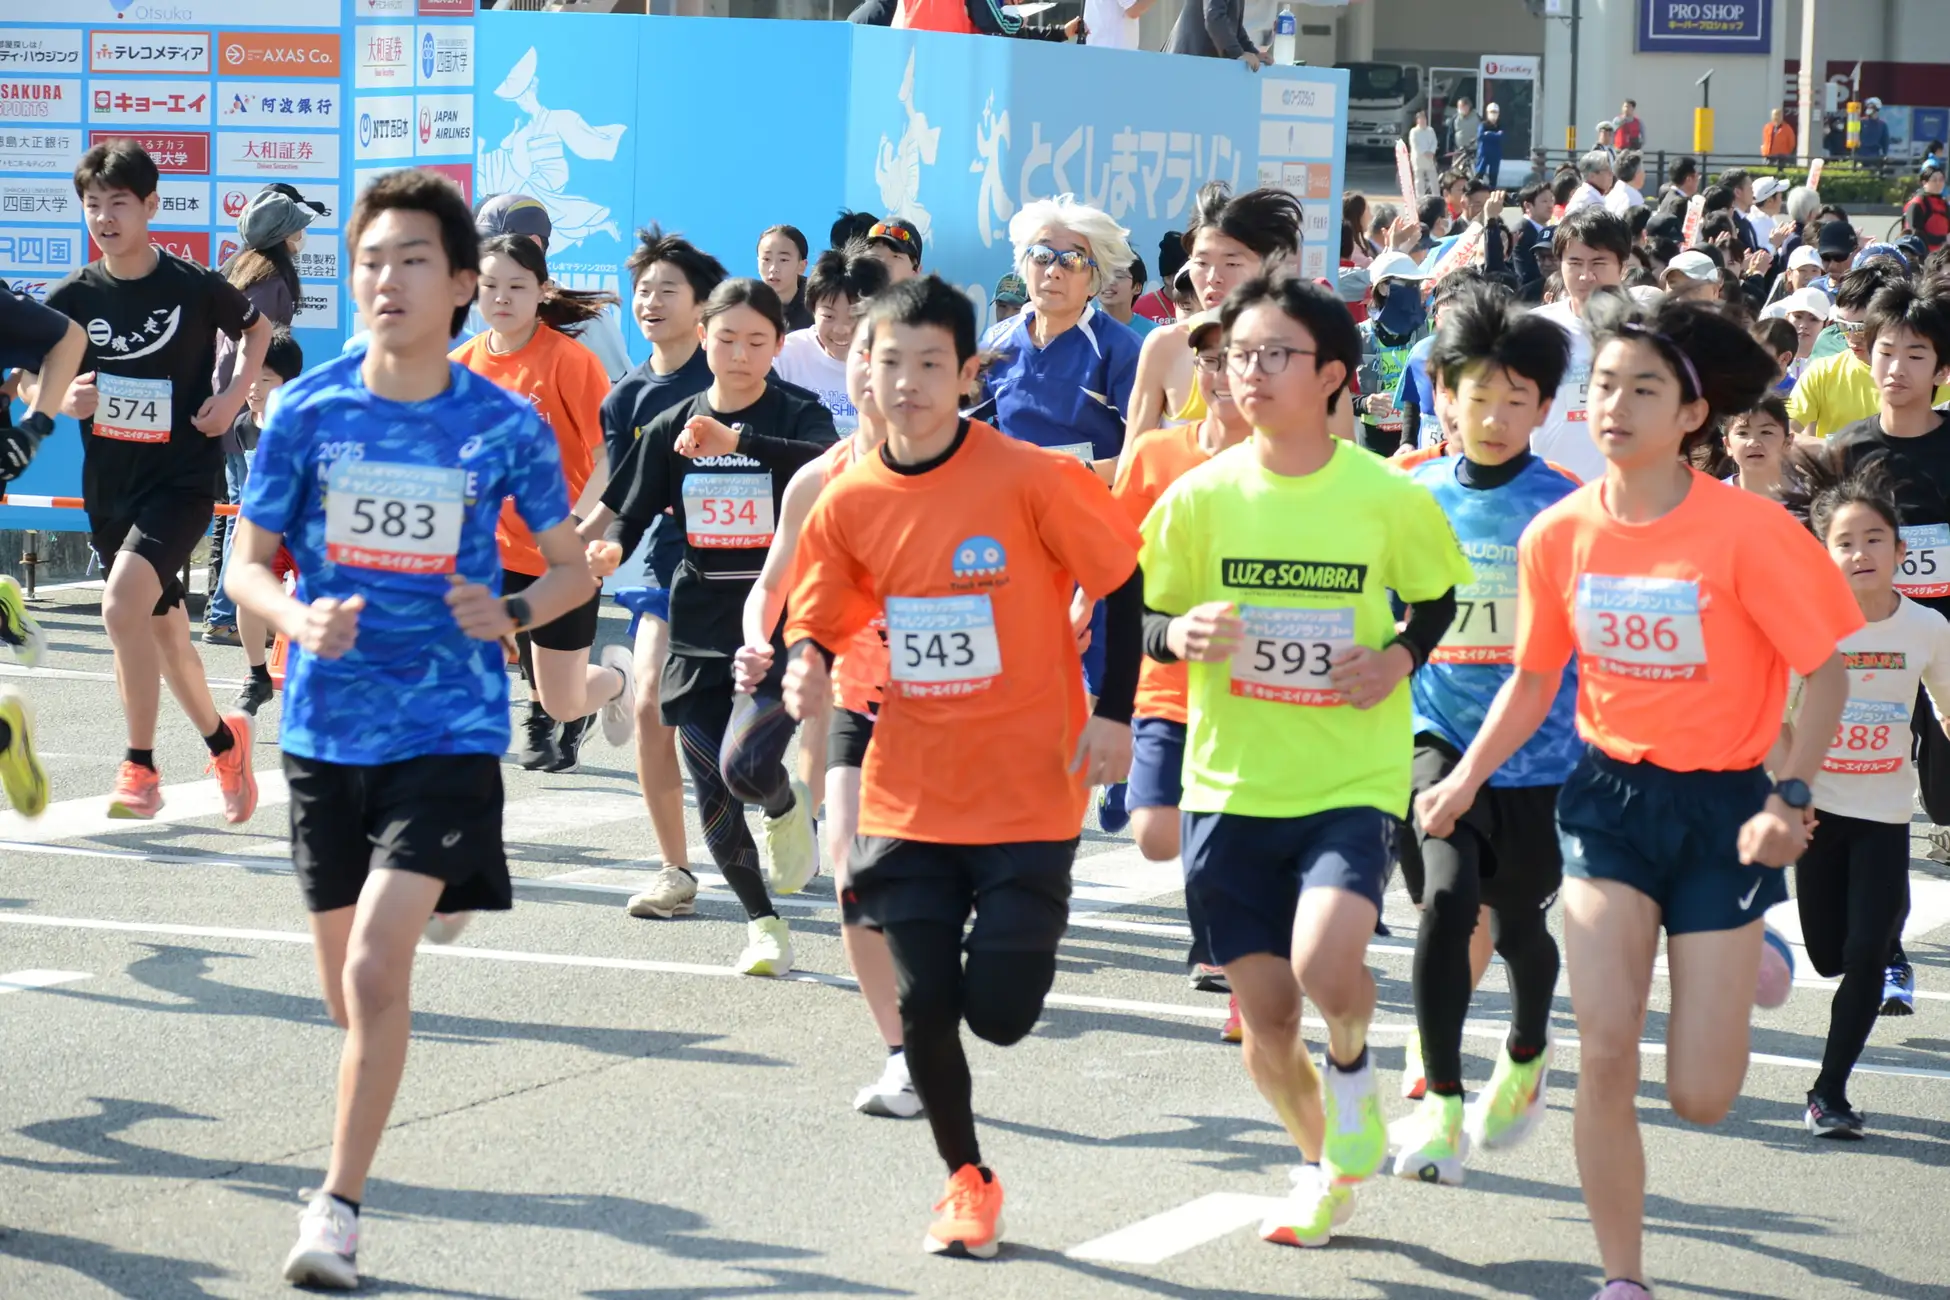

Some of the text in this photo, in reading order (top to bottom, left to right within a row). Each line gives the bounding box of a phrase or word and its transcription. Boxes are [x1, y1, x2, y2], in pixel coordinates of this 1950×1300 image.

[136, 5, 192, 21] Otsuka
[1668, 4, 1744, 20] PRO SHOP
[115, 46, 204, 60] テレコメディア
[263, 49, 305, 63] AXAS
[309, 49, 333, 63] Co.
[368, 36, 402, 62] 大和証券
[437, 51, 467, 73] 四国大学
[115, 92, 207, 113] キョーエイ
[262, 97, 333, 116] 阿波銀行
[434, 111, 458, 123] JAPAN
[435, 127, 470, 140] AIRLINES
[242, 140, 313, 160] 大和証券
[4, 195, 68, 213] 四国大学
[107, 396, 158, 422] 574
[351, 498, 436, 540] 583
[702, 498, 758, 525] 534
[1901, 549, 1937, 576] 65
[1456, 601, 1498, 634] 71
[1598, 611, 1679, 652] 386
[905, 632, 975, 668] 543
[1254, 639, 1333, 676] 593
